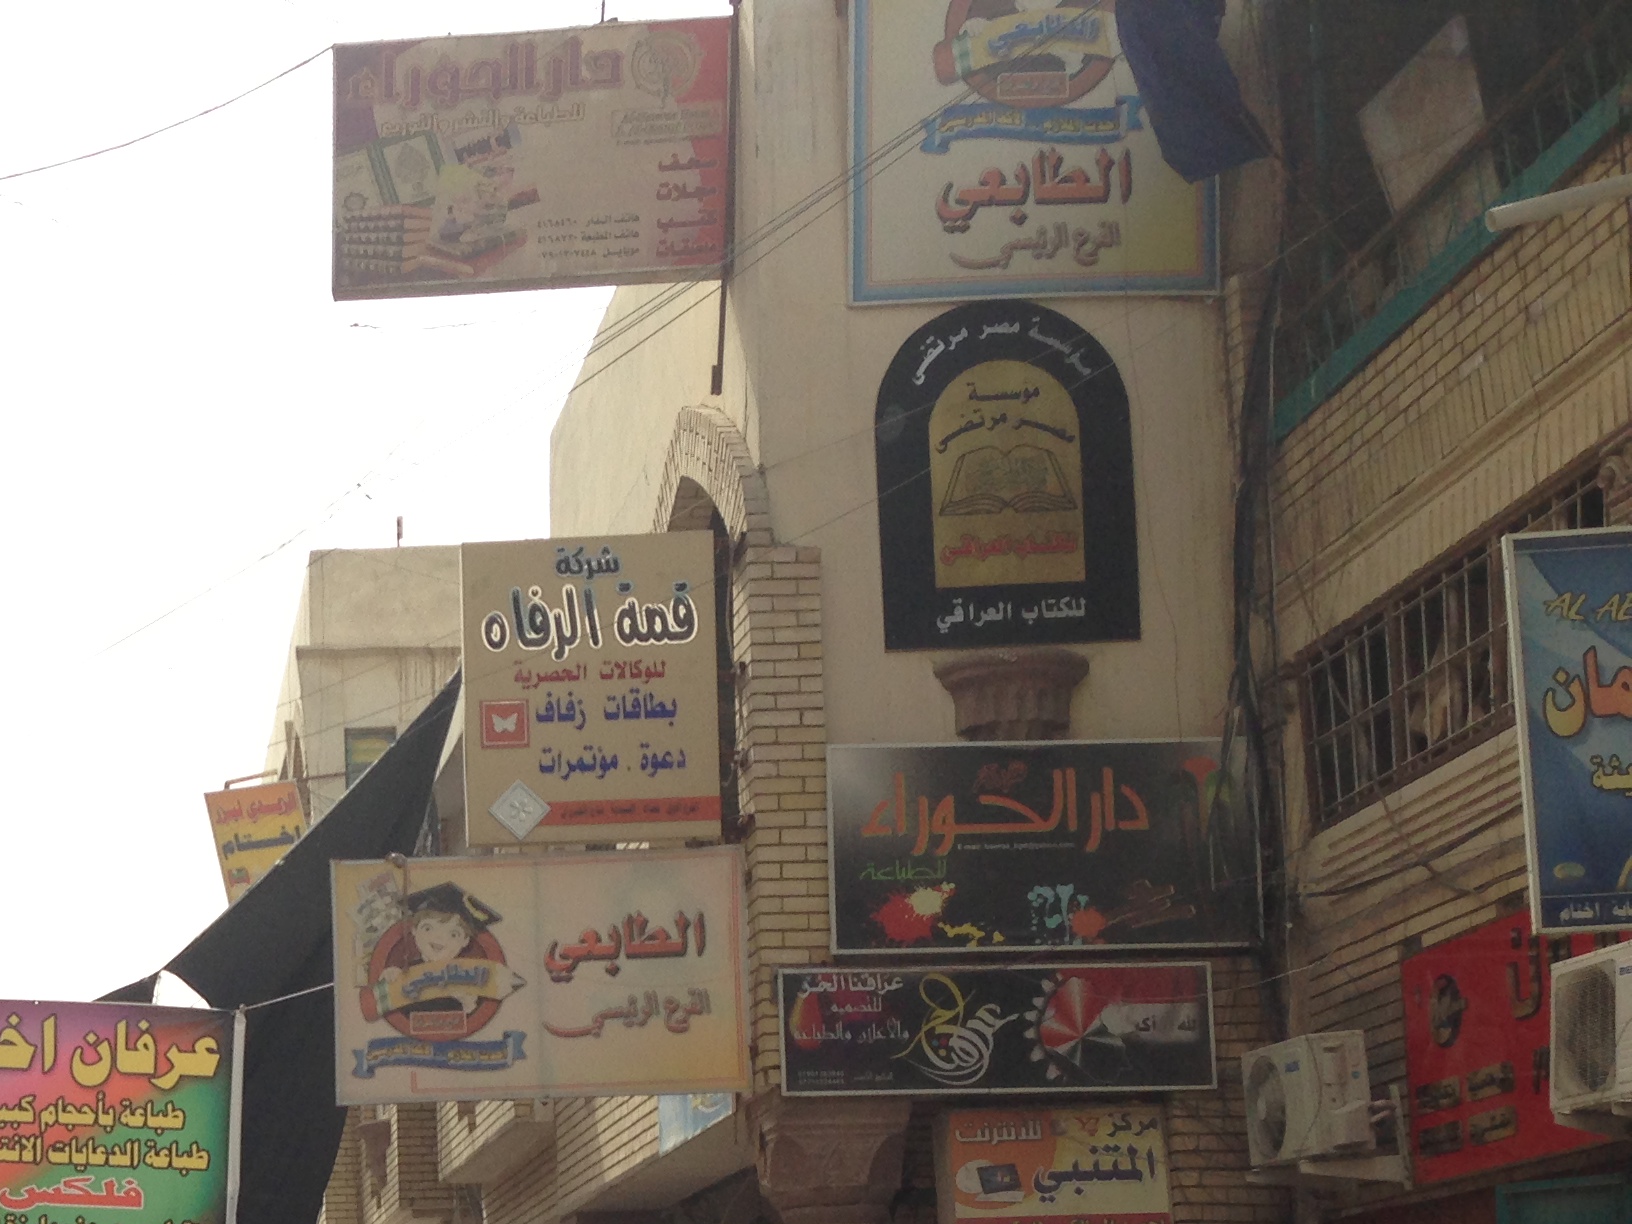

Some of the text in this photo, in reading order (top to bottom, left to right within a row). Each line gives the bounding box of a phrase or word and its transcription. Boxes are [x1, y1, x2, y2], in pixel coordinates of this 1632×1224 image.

[936, 147, 1132, 233] الطابعي
[555, 546, 621, 579] شركة
[481, 582, 699, 662] قمة الرفاه
[1020, 597, 1087, 625] للكتاب
[514, 659, 667, 689] للوكالات الحصرية
[535, 688, 679, 730] بطاقات زفاف
[1084, 766, 1150, 853] دار
[544, 911, 706, 982] الطابعي
[71, 1019, 221, 1090] عرفان
[41, 1096, 115, 1130] بأحجام
[118, 1098, 187, 1131] طباعة
[1106, 1112, 1159, 1138] مركز
[47, 1138, 141, 1173] الدعايات
[144, 1138, 212, 1175] طباعة
[1032, 1141, 1157, 1204] المتنبي
